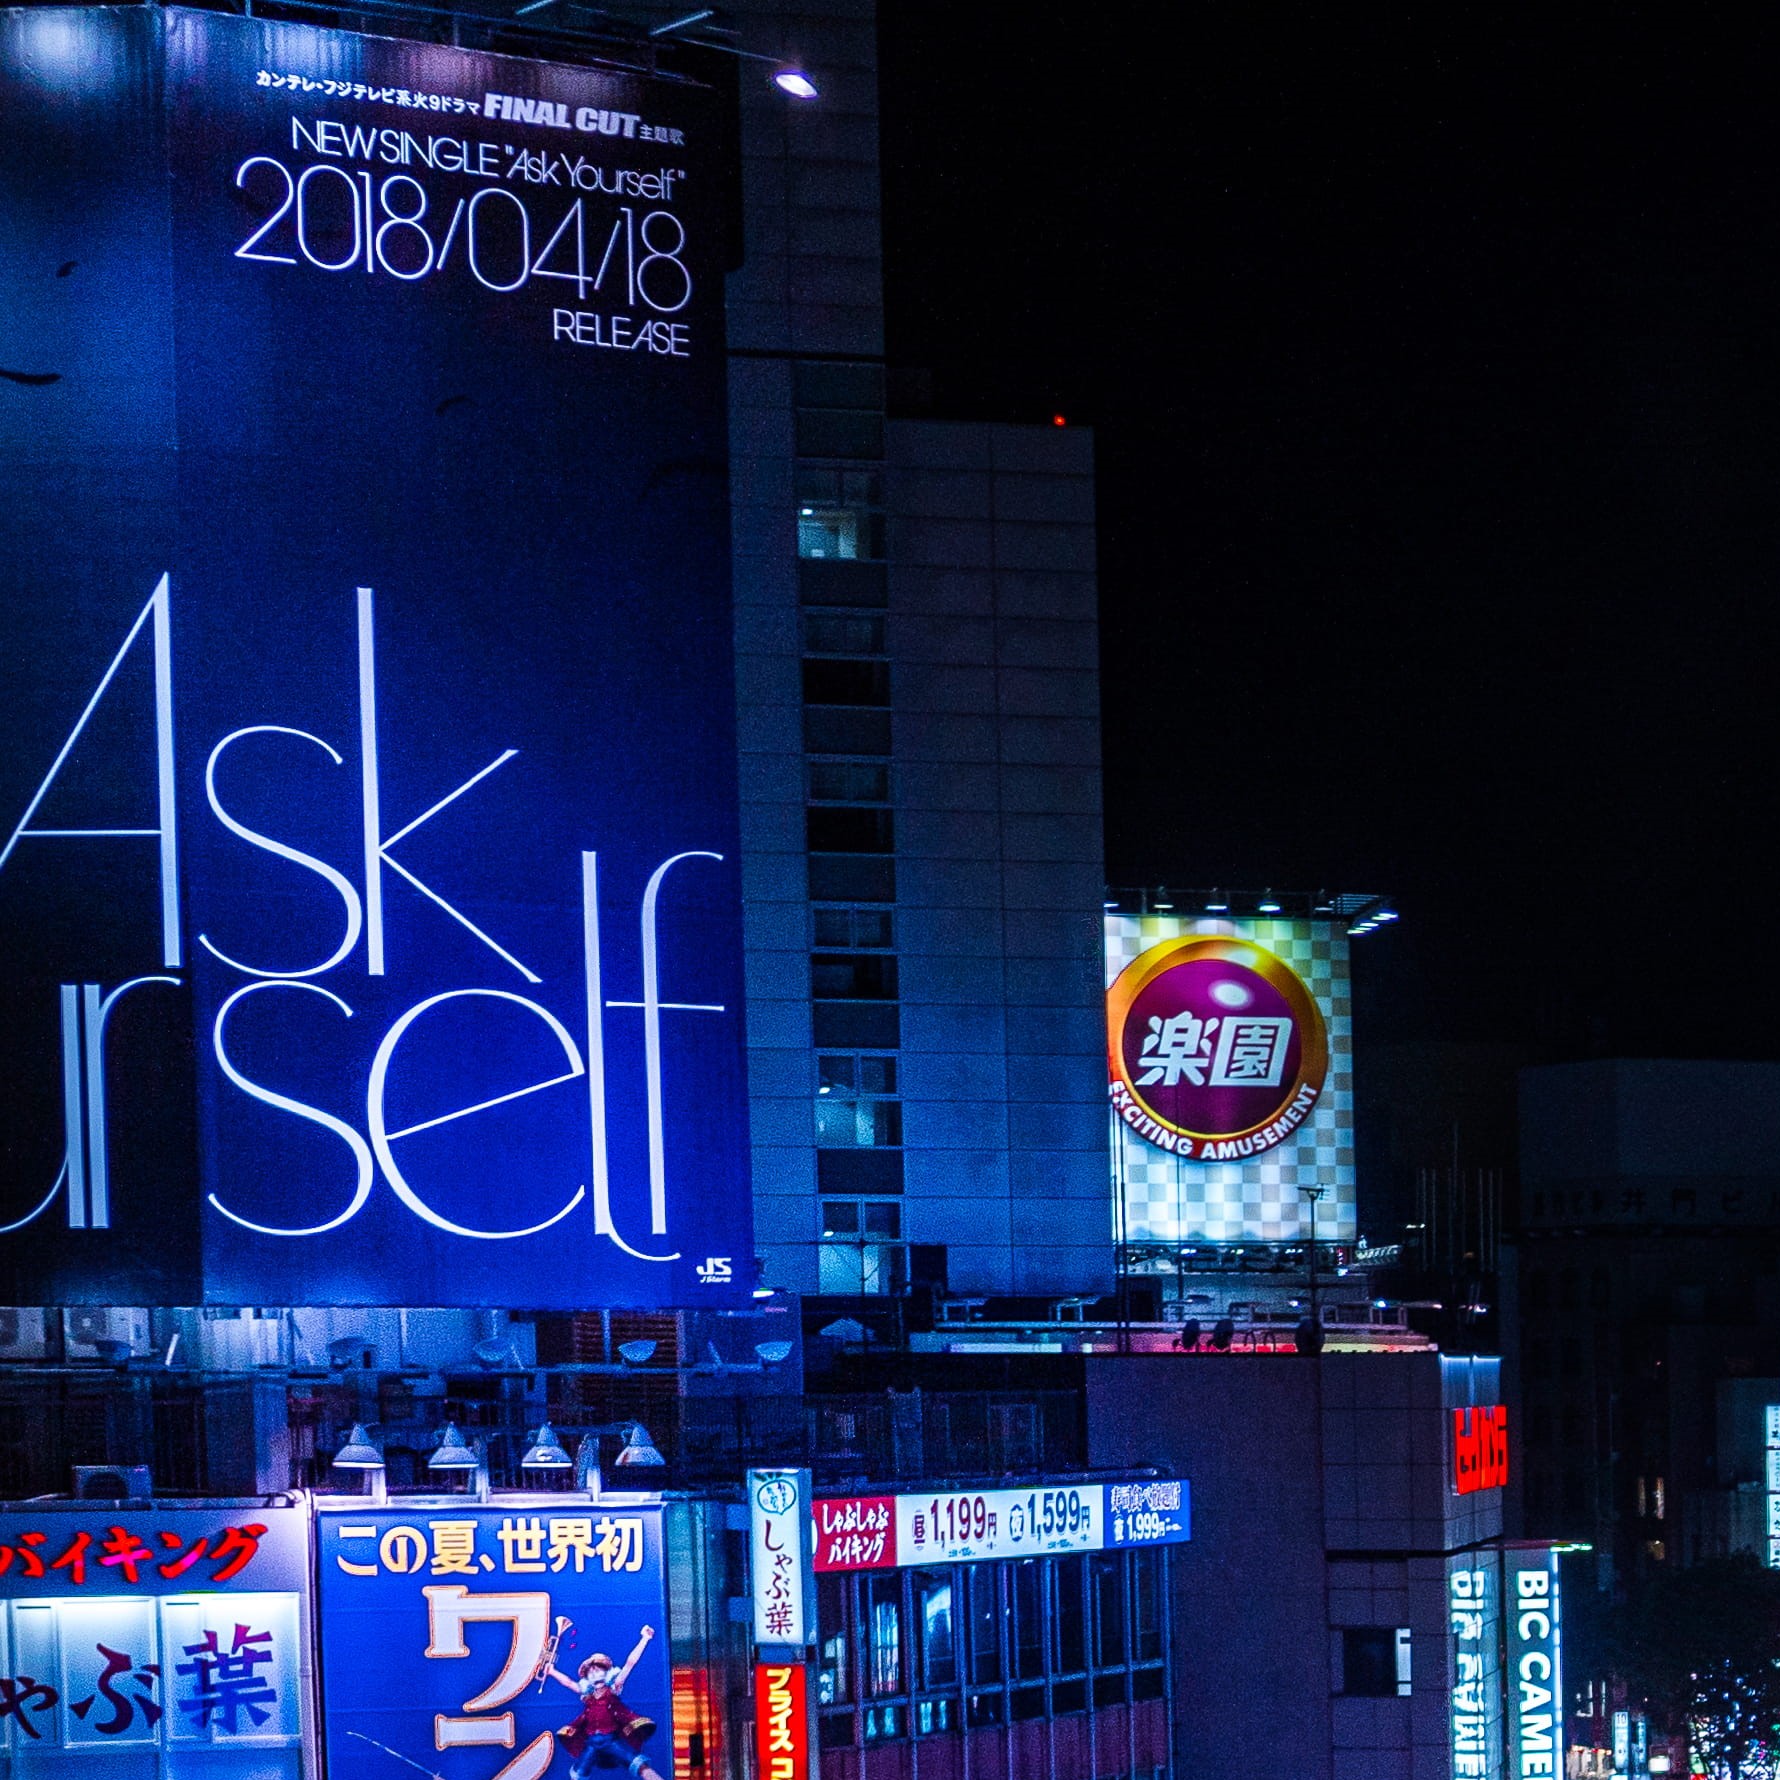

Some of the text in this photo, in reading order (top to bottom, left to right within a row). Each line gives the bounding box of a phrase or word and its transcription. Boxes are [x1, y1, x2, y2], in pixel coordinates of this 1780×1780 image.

[291, 119, 377, 160] NEW
[378, 128, 501, 177] SINGLE
[483, 92, 571, 131] FINAL
[575, 105, 640, 138] CUT
[234, 156, 692, 312] 2018/04/18
[553, 309, 690, 357] RELEASE
[0, 572, 542, 982] Ask
[1135, 1011, 1293, 1087] 楽園
[1109, 1080, 1318, 1161] EXCITING AMUSEMENT
[336, 1516, 644, 1577] この夏、世界初
[821, 1498, 890, 1535] しゃぶしゃぶ
[827, 1530, 888, 1564] バイキング
[764, 1520, 795, 1637] しゃぶ葉
[1517, 1568, 1553, 1643] BIC
[767, 1668, 795, 1753] プライス
